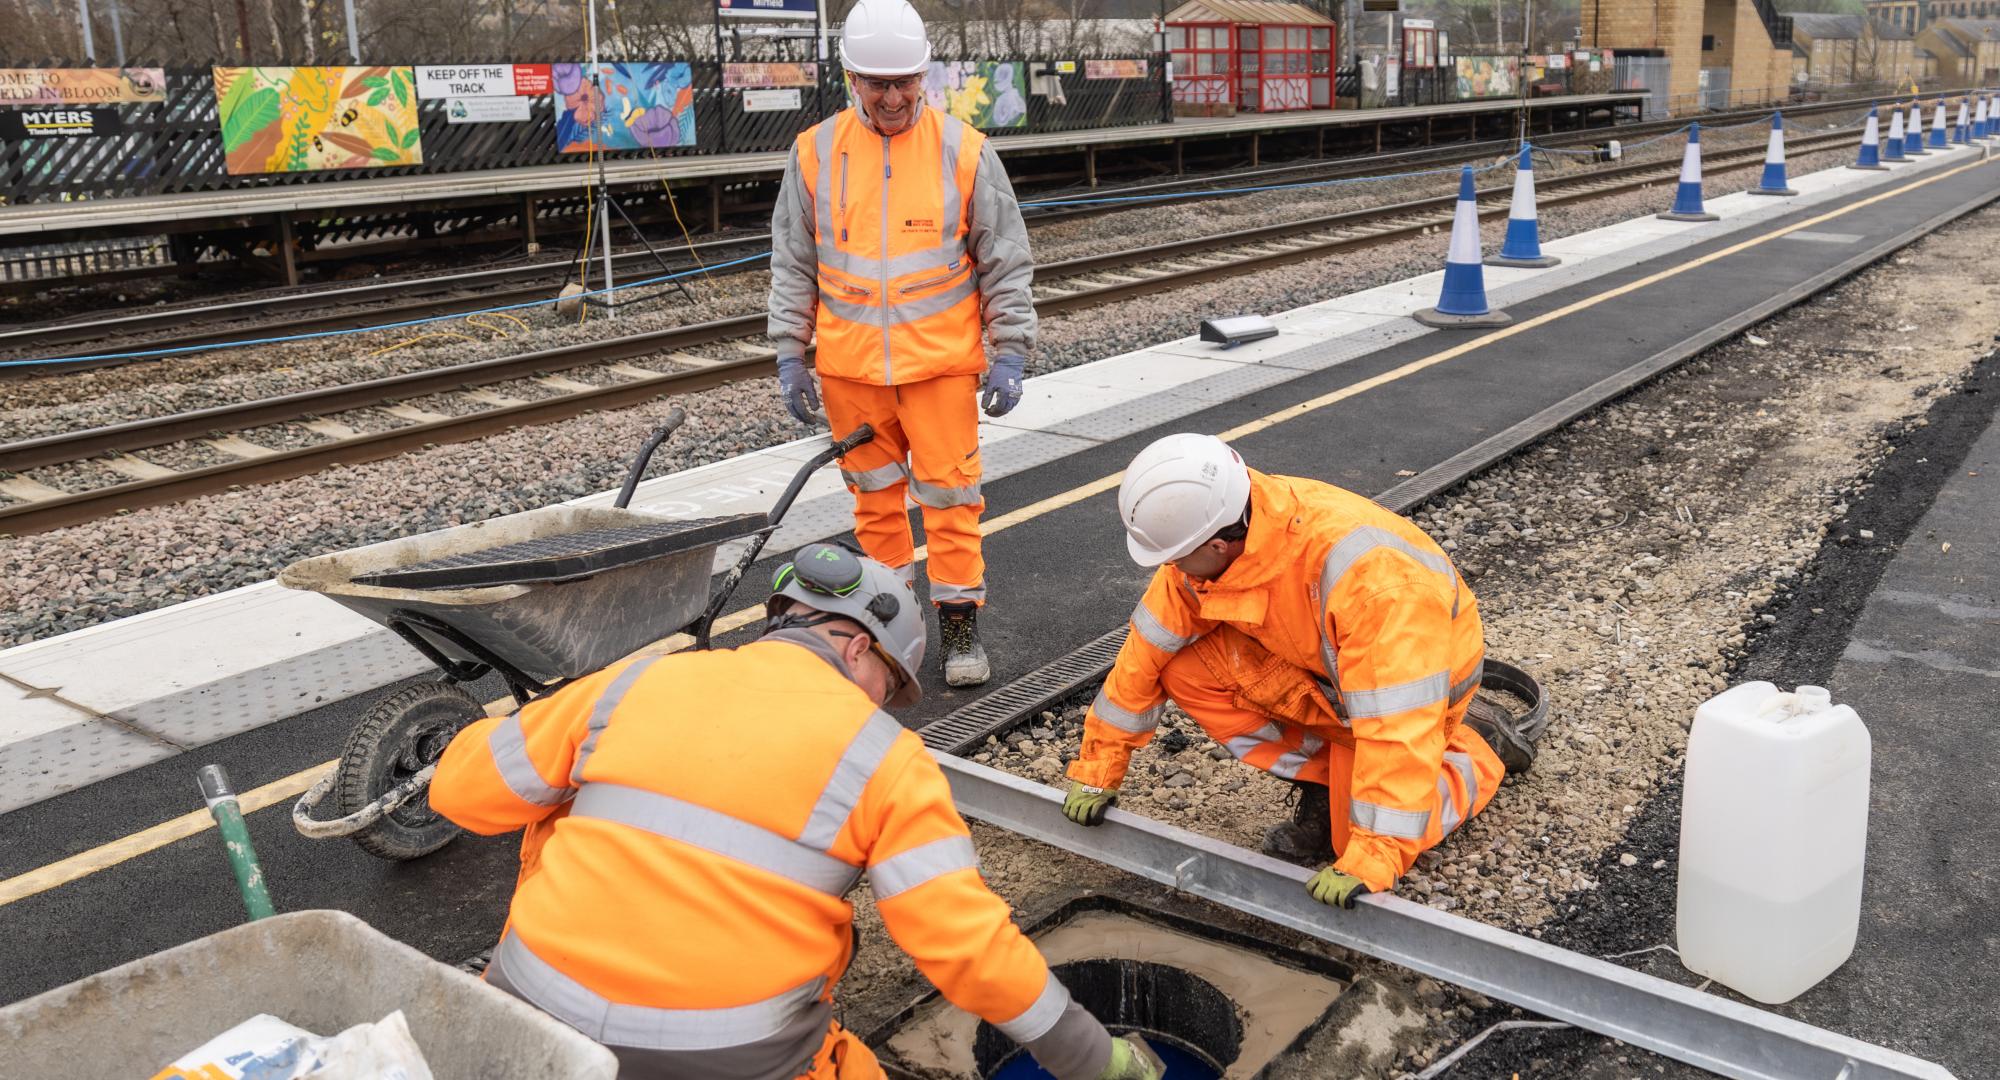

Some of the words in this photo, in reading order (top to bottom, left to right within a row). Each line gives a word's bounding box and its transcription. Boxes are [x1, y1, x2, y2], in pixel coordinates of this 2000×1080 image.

[38, 72, 60, 85] TO
[427, 69, 456, 80] KEEP
[458, 69, 480, 79] OFF
[481, 68, 503, 78] THE
[39, 86, 58, 99] IN
[63, 86, 120, 98] BLOOM
[449, 83, 486, 94] TRACK
[21, 111, 94, 124] MYERS
[27, 128, 57, 136] Timber
[58, 127, 93, 135] Supplies
